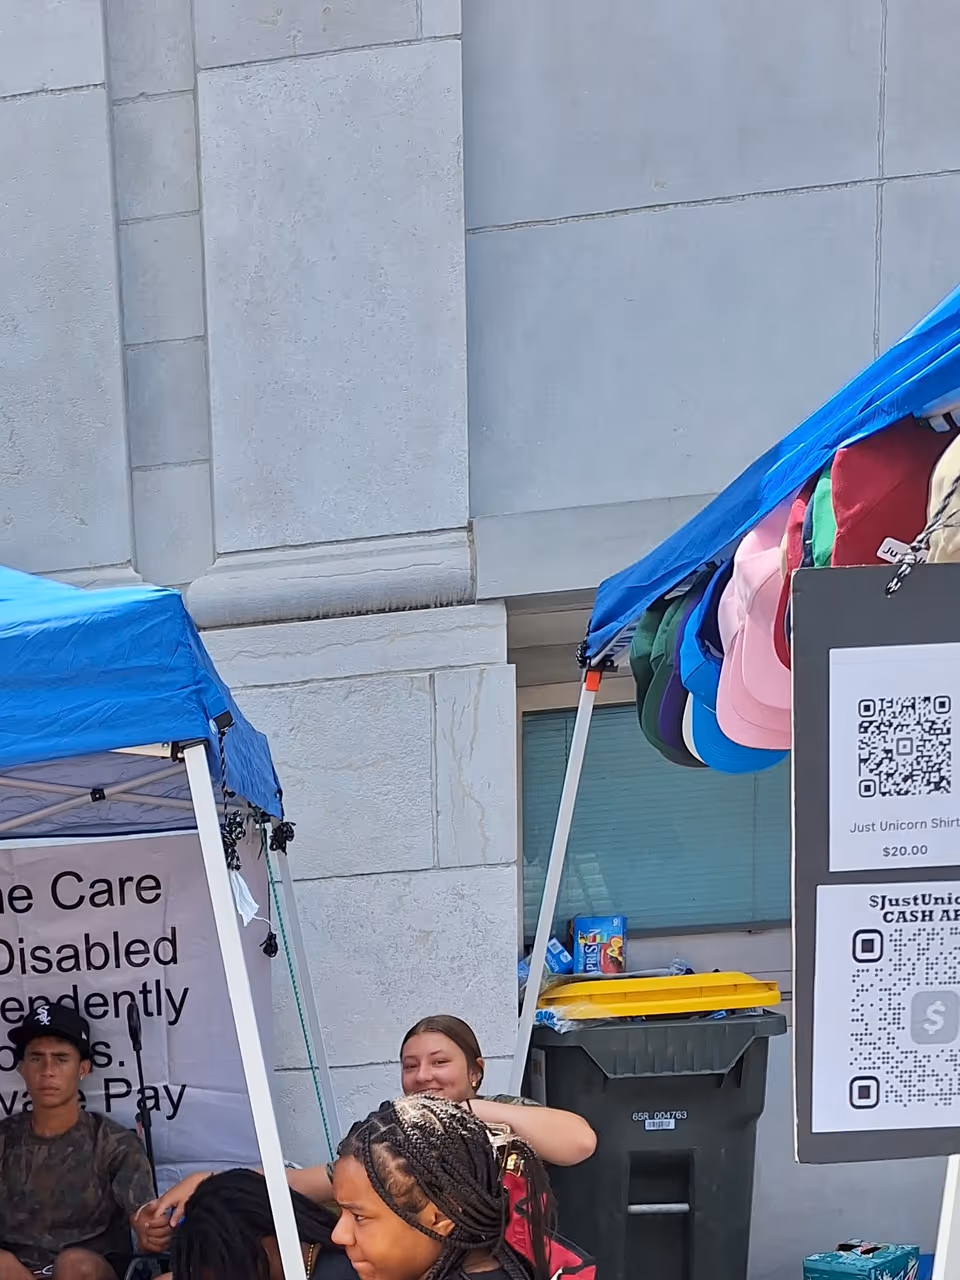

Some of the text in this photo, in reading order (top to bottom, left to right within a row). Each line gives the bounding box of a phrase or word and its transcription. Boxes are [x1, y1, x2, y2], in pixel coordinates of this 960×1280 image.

[849, 821, 876, 833] Just
[879, 819, 928, 832] Unicorn
[882, 844, 928, 857] $20.00
[51, 870, 162, 910] Care
[882, 909, 934, 924] CASH
[104, 1077, 187, 1121] Pay
[632, 1110, 688, 1121] 65R 004763
